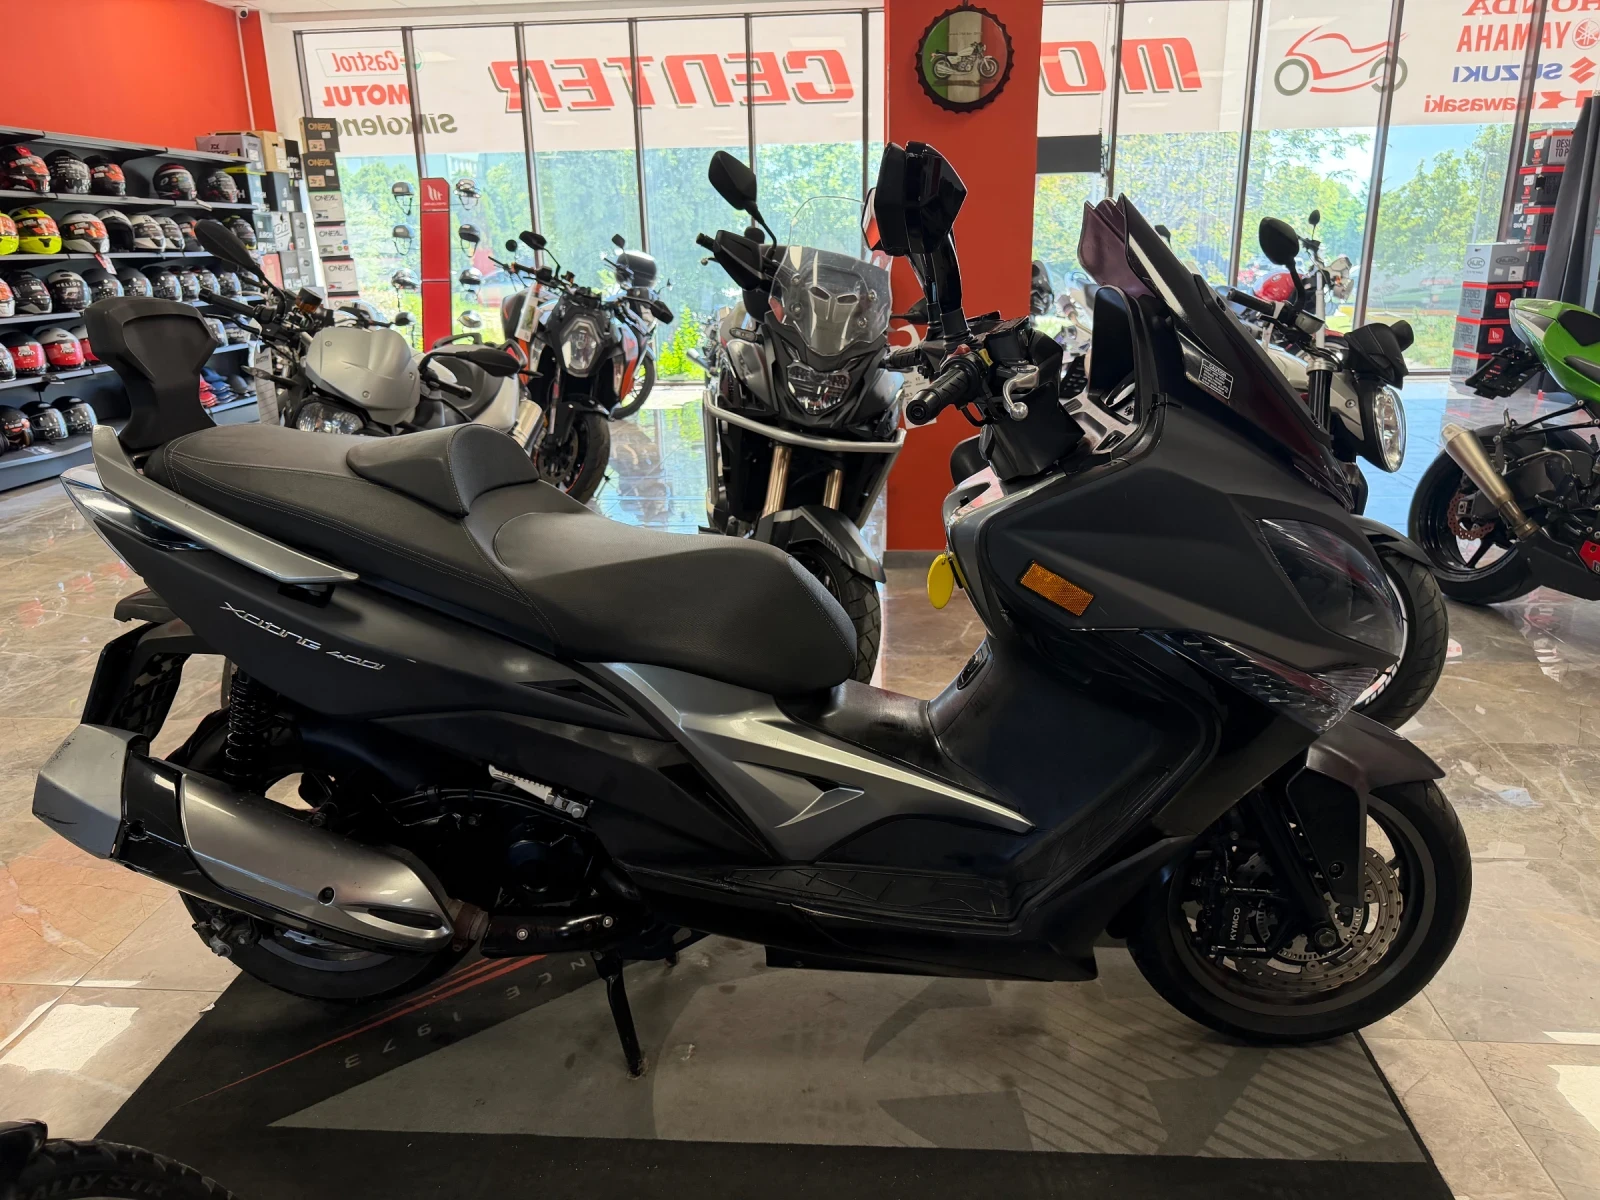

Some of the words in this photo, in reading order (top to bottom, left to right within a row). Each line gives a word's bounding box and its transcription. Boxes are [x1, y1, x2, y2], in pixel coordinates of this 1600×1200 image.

[1556, 139, 1571, 148] DESI
[326, 650, 385, 670] 400i
[1229, 907, 1241, 940] KYMCO
